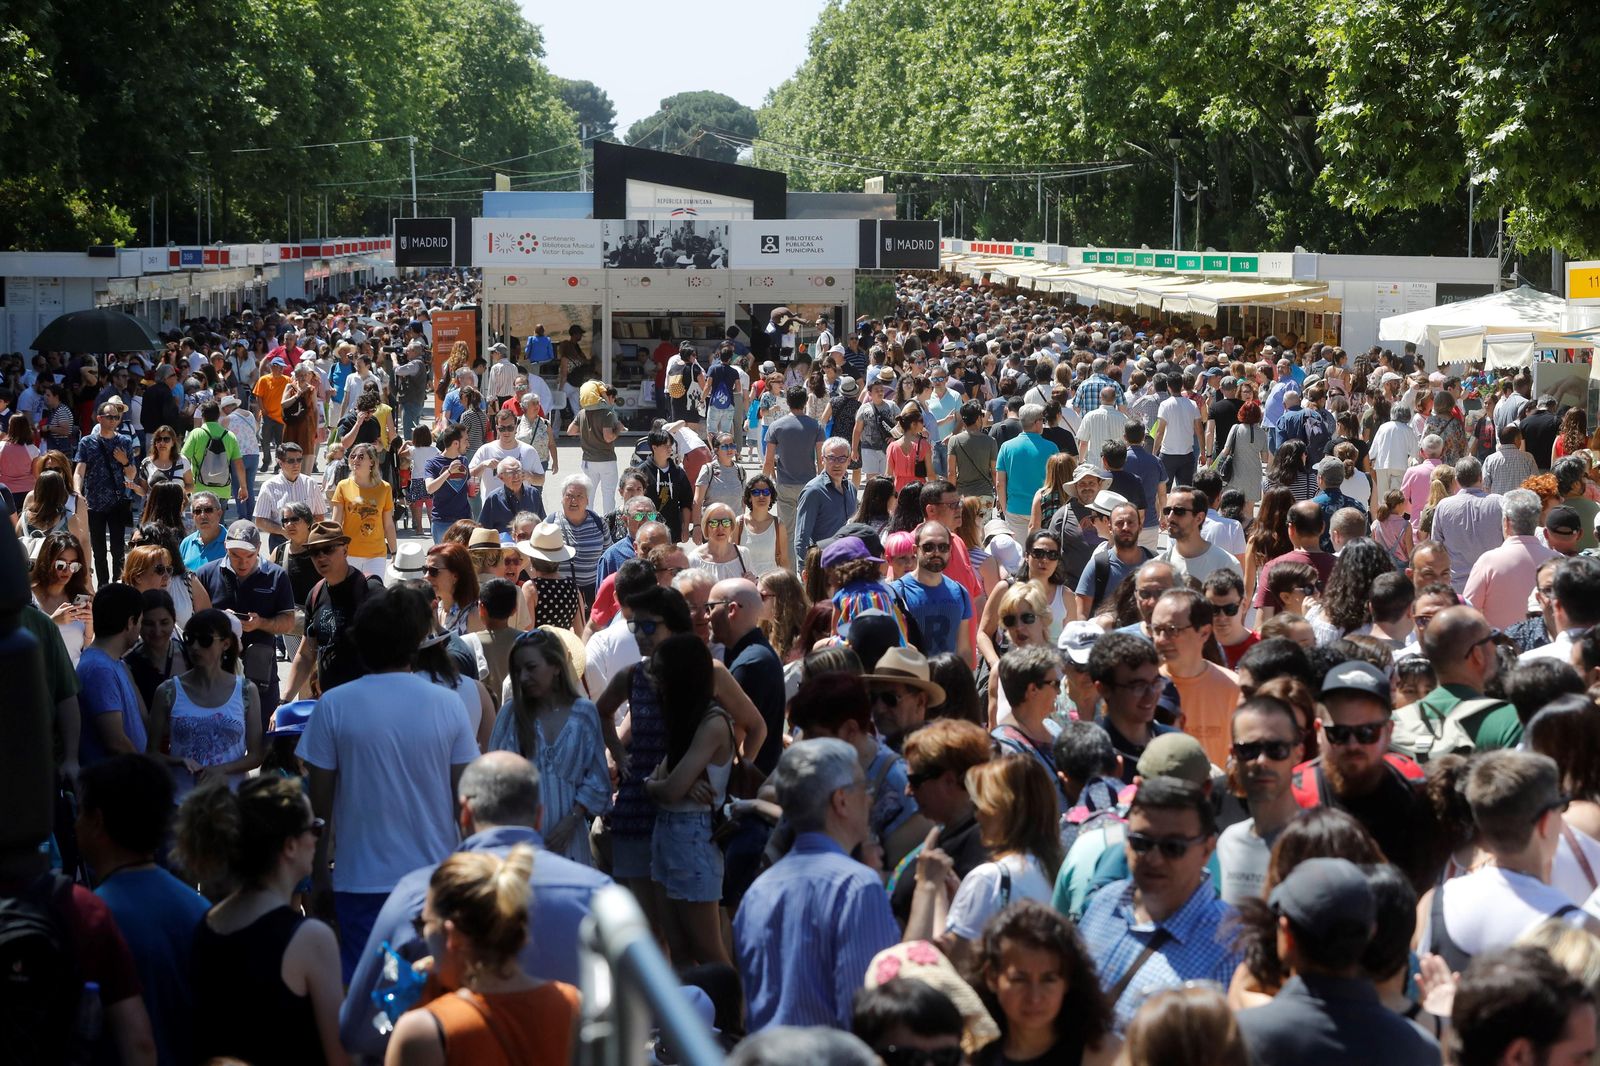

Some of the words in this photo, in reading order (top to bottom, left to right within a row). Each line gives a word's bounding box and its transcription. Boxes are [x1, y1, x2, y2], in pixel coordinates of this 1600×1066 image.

[412, 237, 448, 249] MADRID
[897, 239, 935, 250] MADRID
[1212, 260, 1222, 268] 119
[1240, 261, 1250, 269] 118
[1271, 261, 1281, 269] 117
[1588, 275, 1600, 289] 11
